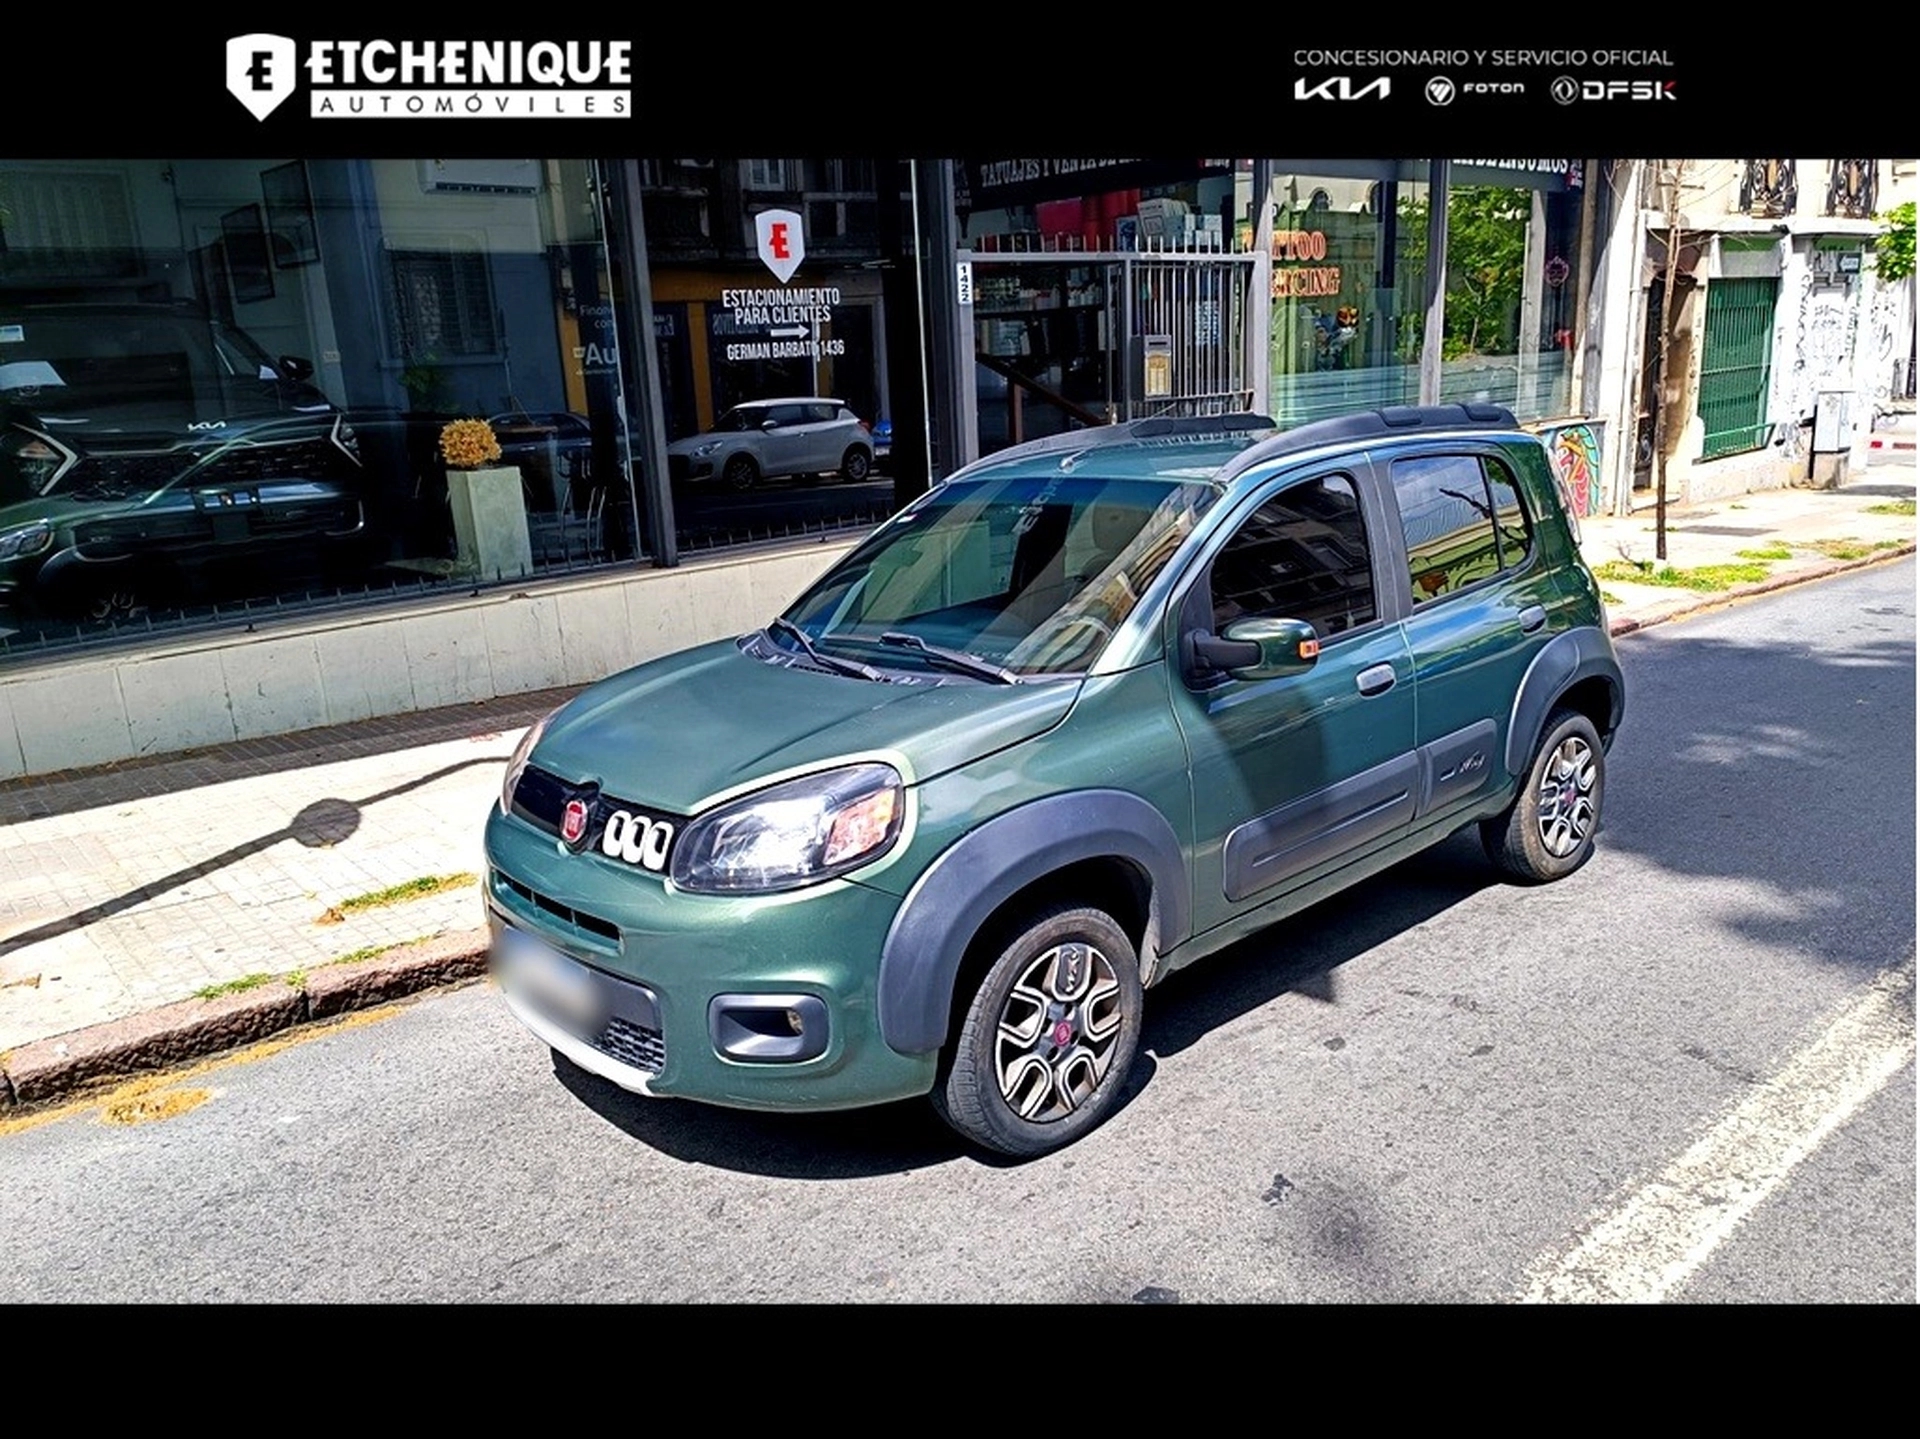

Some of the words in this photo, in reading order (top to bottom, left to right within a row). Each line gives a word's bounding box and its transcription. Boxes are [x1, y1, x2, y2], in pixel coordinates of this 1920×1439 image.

[980, 159, 1040, 188] TATUAJES
[959, 264, 970, 303] 1422
[722, 287, 840, 308] ESTACIONAMIENTO
[734, 307, 771, 325] PARA
[772, 305, 832, 325] CLIENTES
[726, 342, 771, 360] GERMAN
[820, 338, 845, 356] 1436
